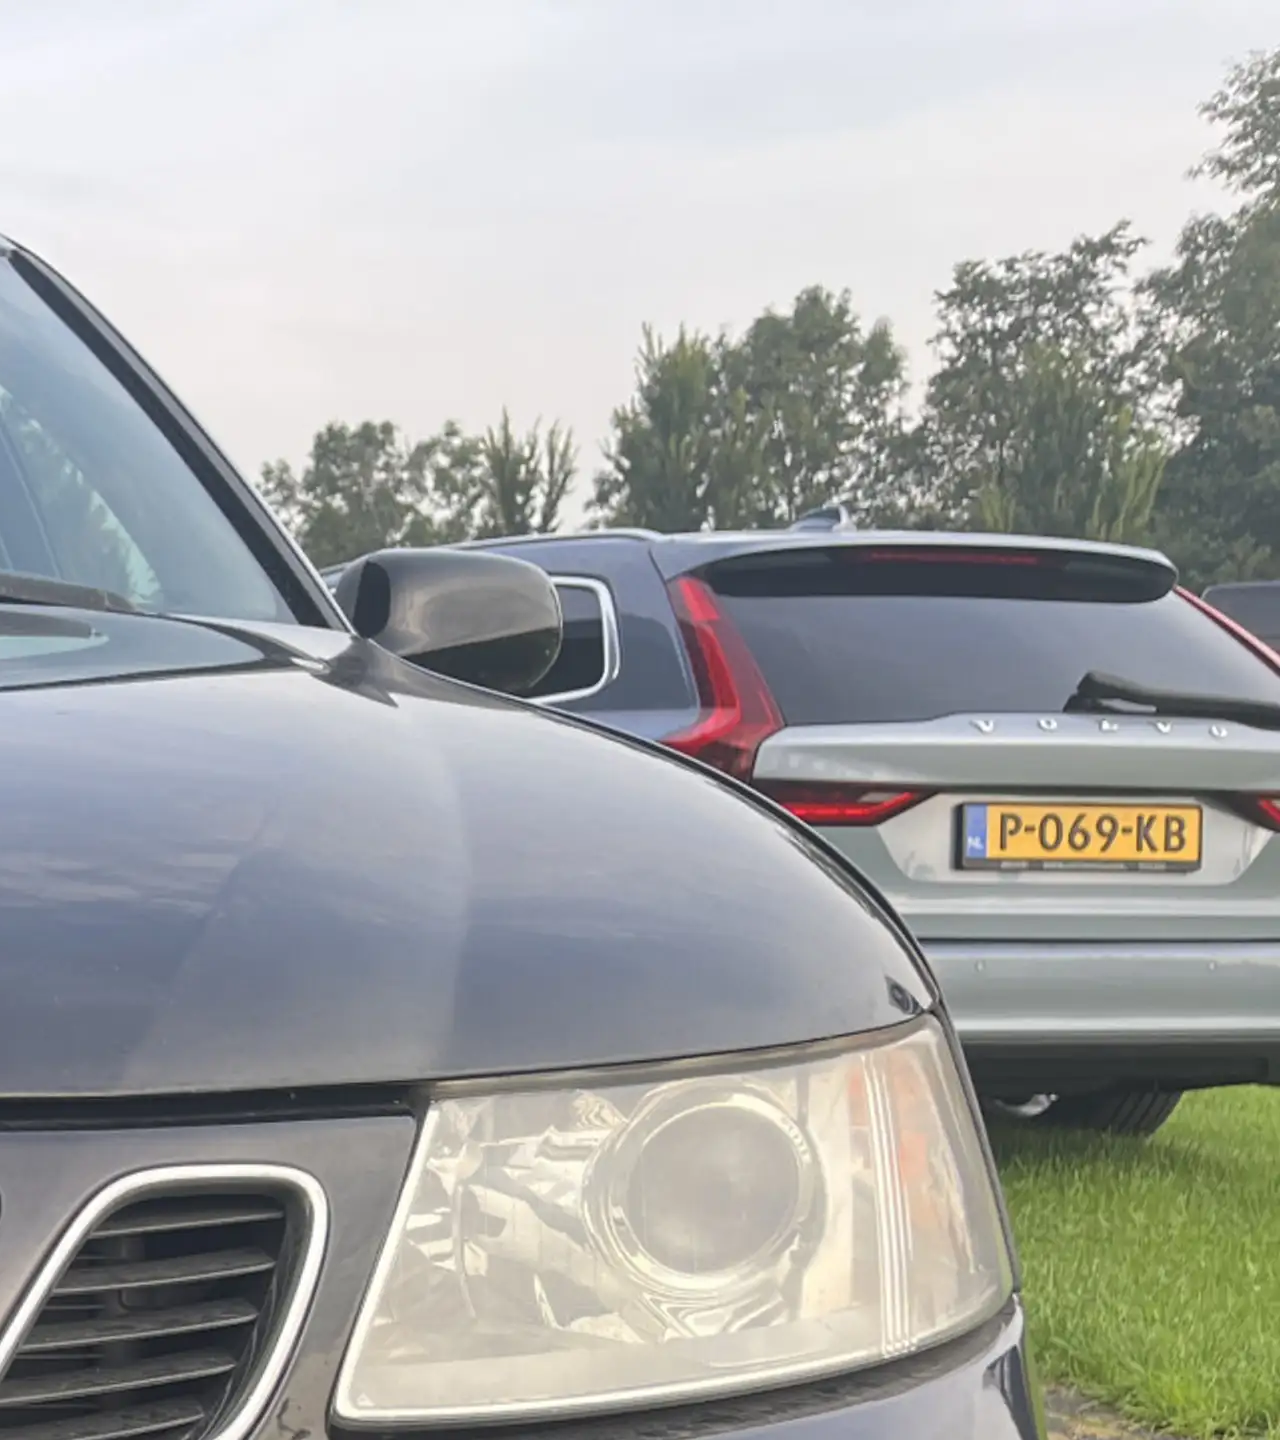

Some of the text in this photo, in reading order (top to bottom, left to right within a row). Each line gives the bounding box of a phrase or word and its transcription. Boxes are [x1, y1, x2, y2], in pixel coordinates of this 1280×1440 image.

[969, 718, 1228, 738] VOLVO
[999, 811, 1187, 853] P-069-KB
[966, 835, 985, 850] NL
